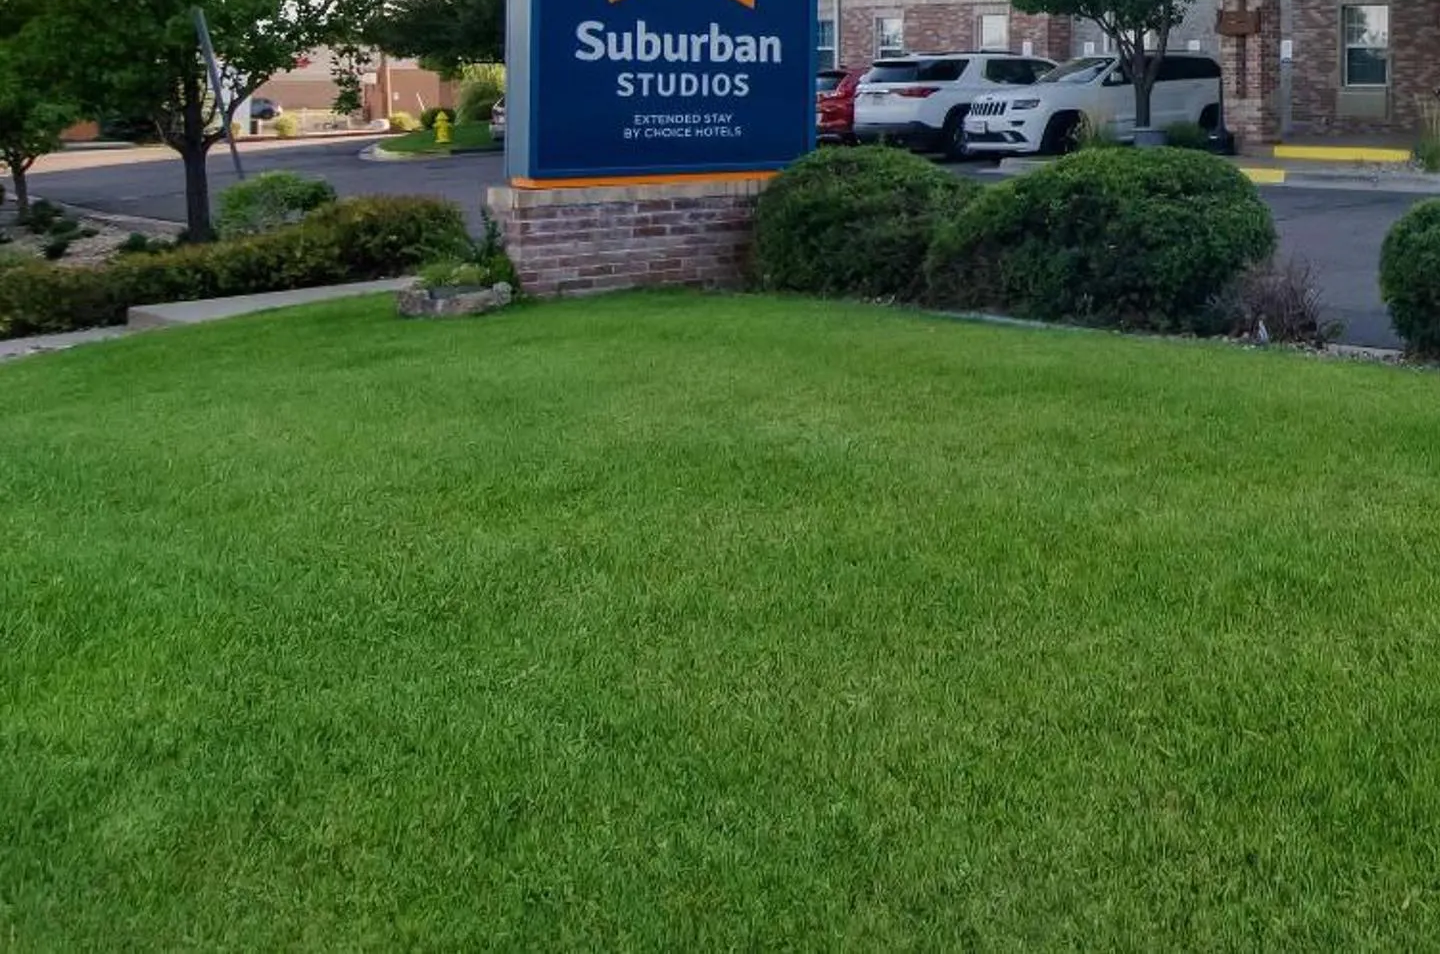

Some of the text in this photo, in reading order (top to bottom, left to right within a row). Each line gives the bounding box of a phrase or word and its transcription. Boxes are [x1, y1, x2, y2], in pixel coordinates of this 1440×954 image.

[575, 20, 782, 63] Suburban
[616, 72, 750, 98] STUDIOS
[634, 113, 733, 126] EXTENDED STAY
[623, 126, 742, 139] BY CHOICE HOTELS
